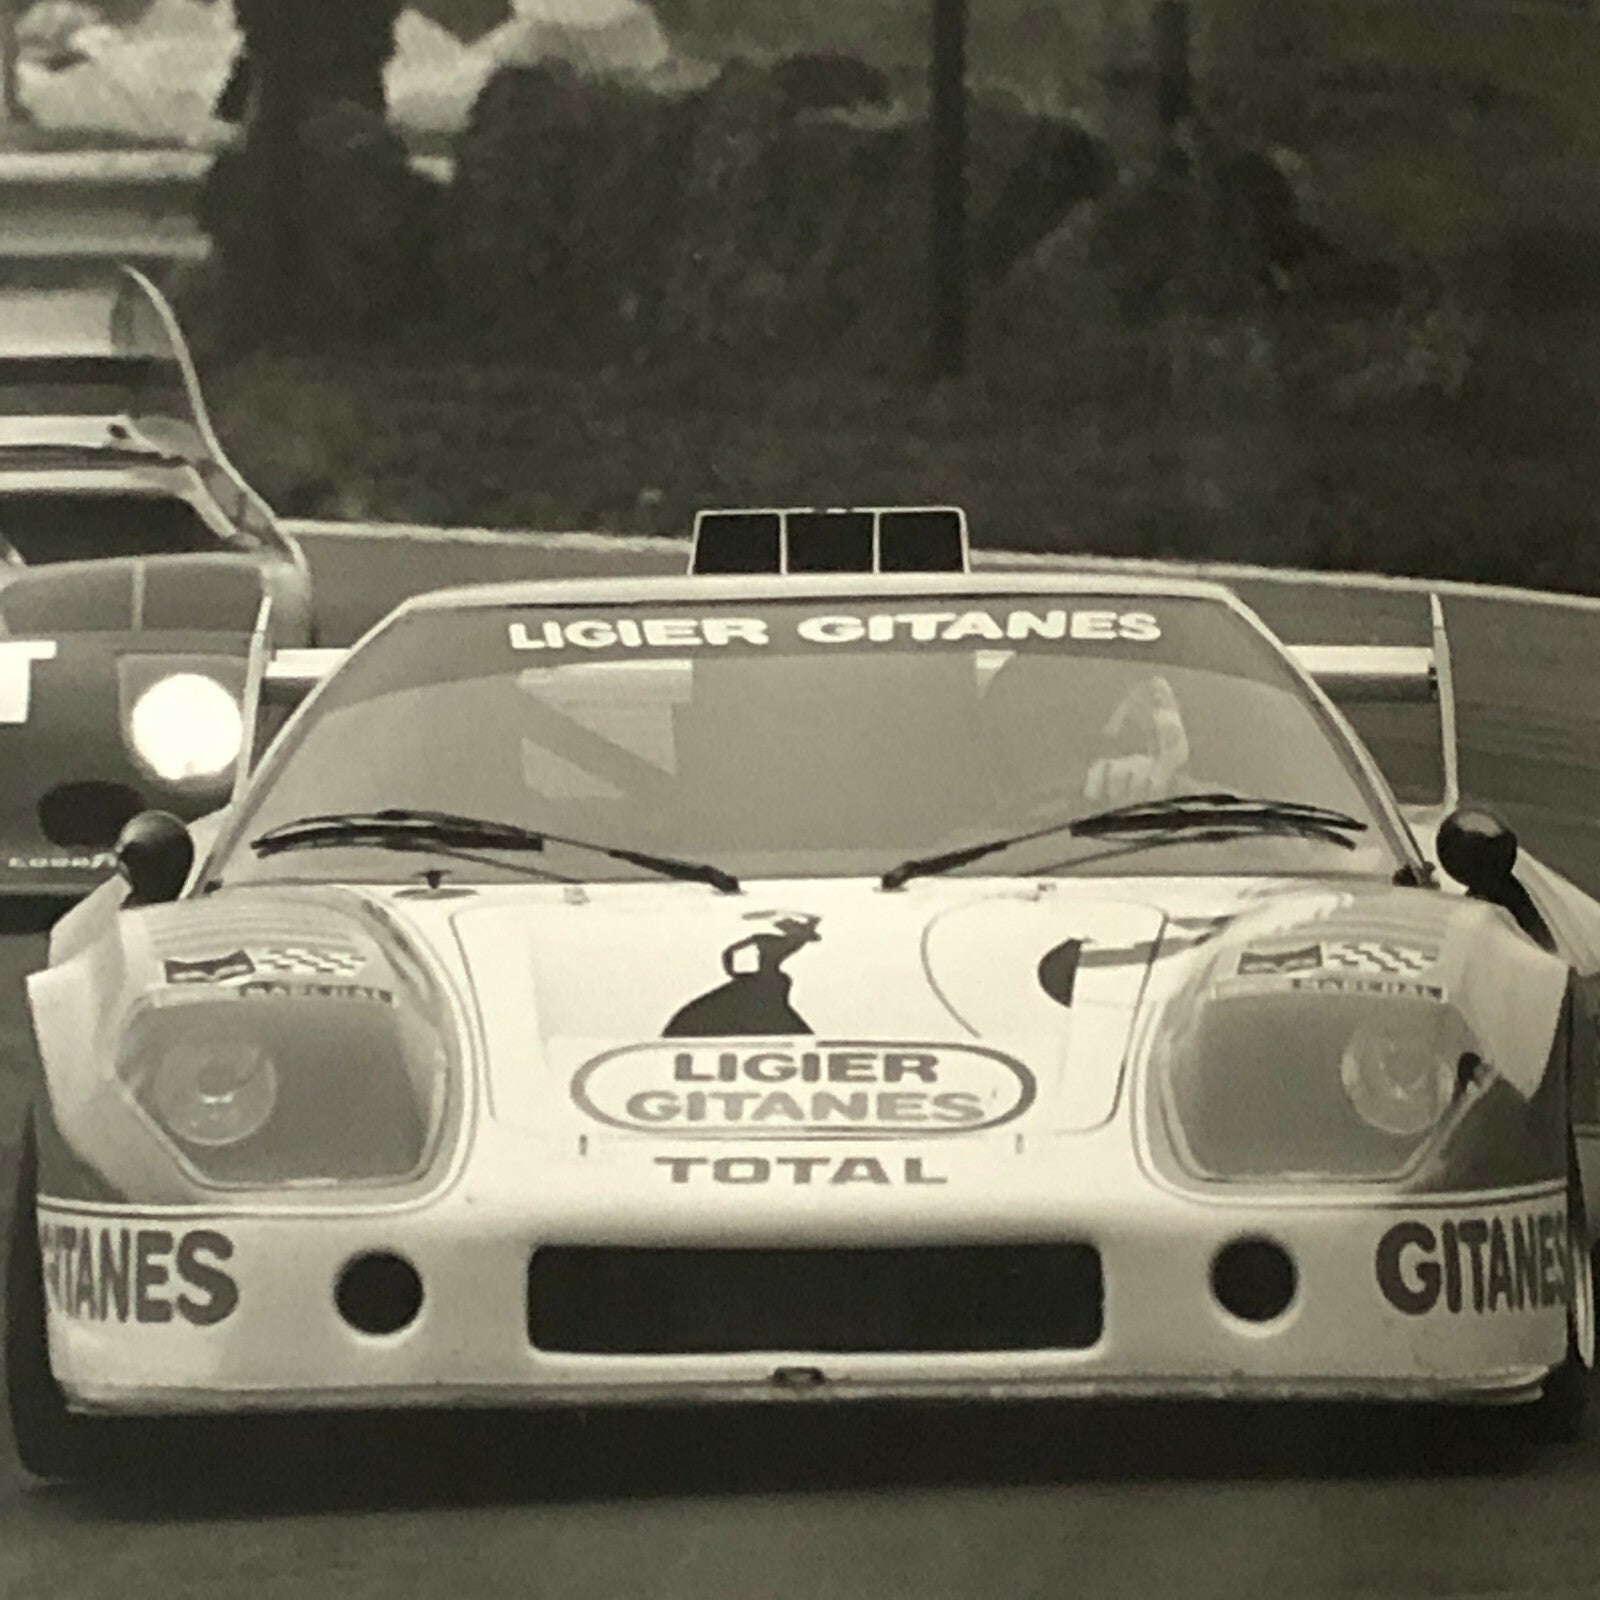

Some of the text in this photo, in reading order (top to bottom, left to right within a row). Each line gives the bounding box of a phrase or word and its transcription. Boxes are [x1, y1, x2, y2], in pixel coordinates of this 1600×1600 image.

[508, 610, 1162, 649] LIGIER GITANES
[673, 1052, 940, 1083] LIGIER
[625, 1090, 985, 1122] GITANES
[653, 1156, 948, 1185] TOTAL
